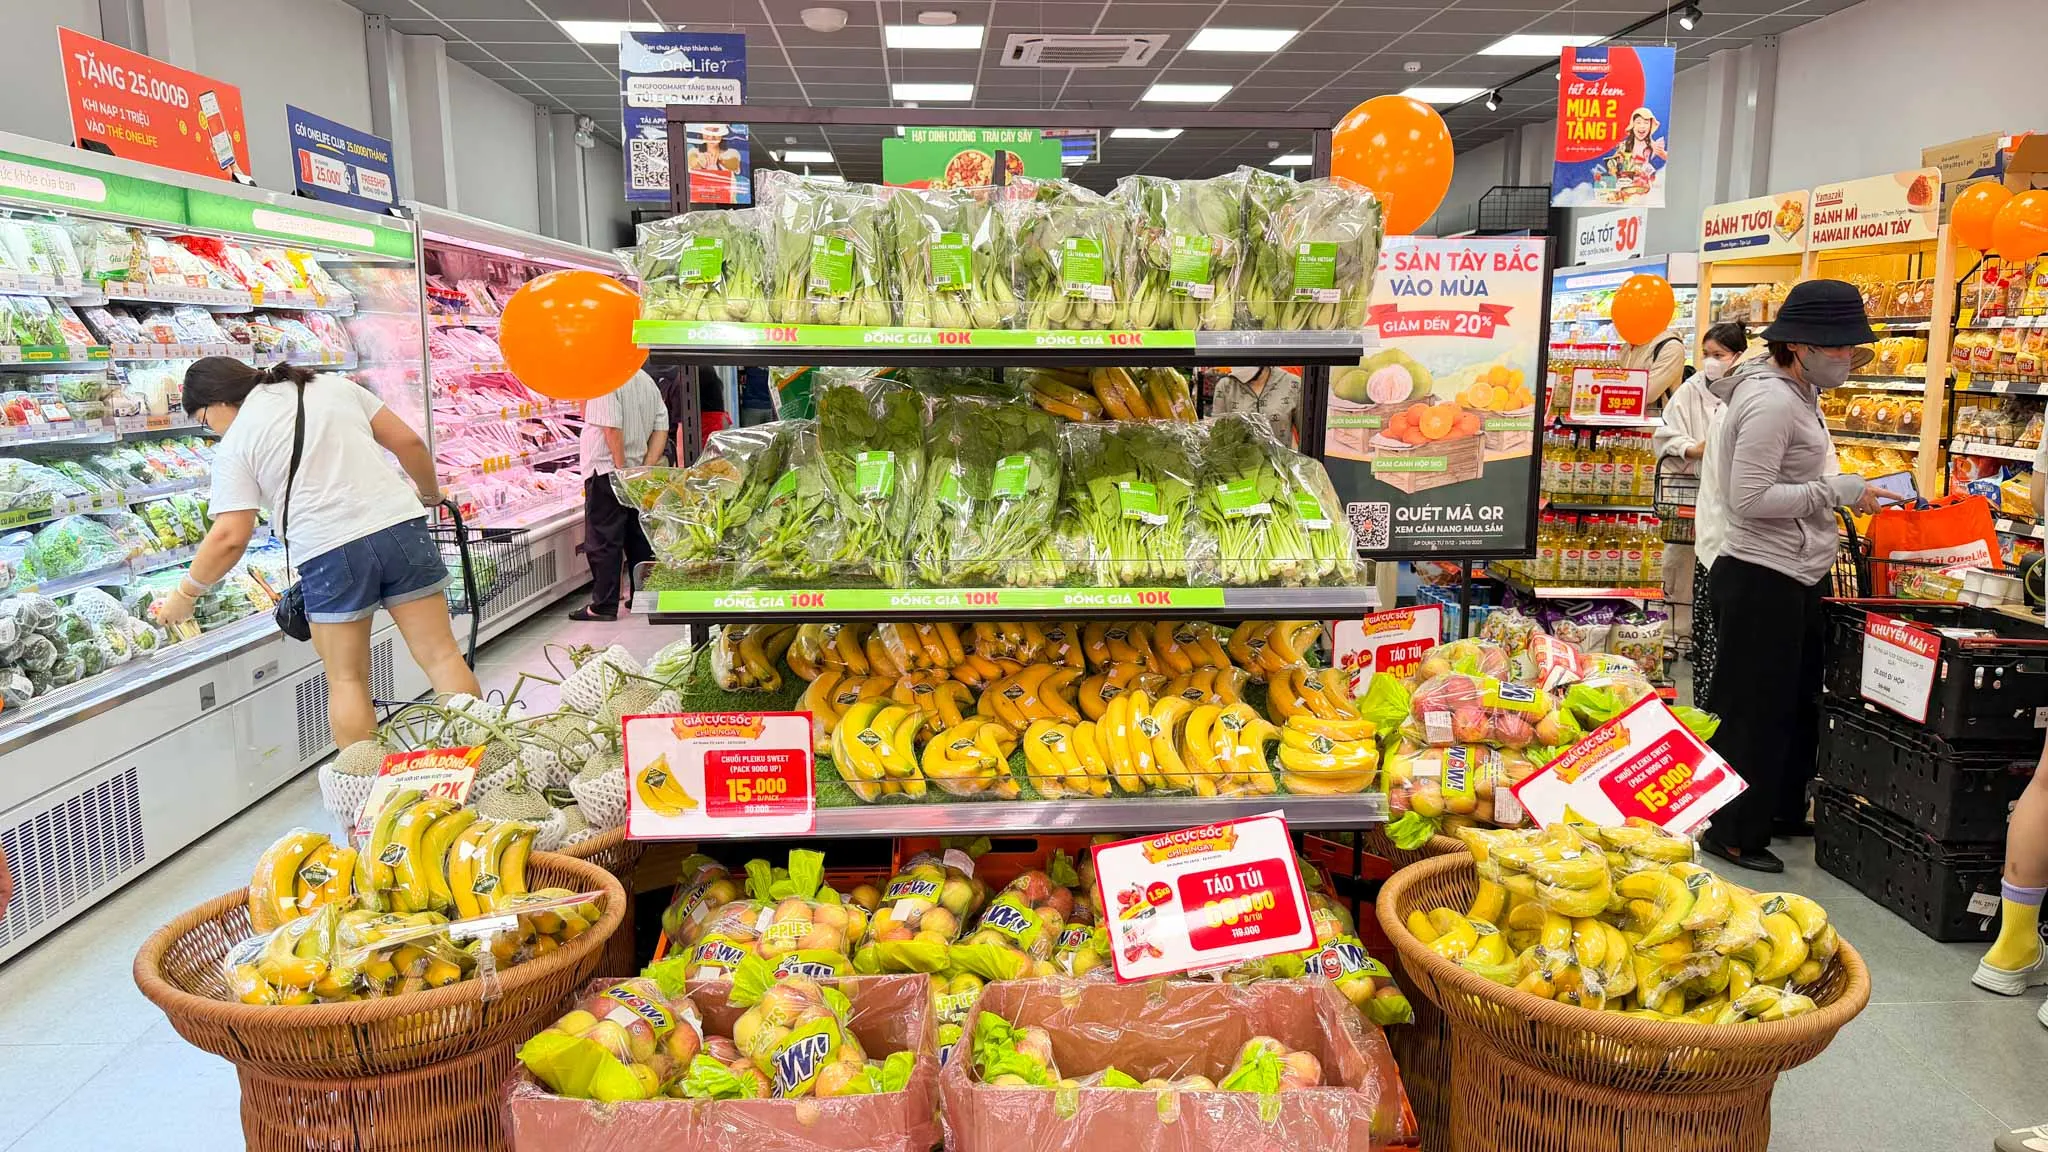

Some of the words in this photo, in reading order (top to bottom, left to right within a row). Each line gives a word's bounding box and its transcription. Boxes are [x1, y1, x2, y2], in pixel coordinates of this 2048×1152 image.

[660, 58, 727, 73] OneLife?
[74, 50, 126, 89] TẶNG
[128, 70, 190, 109] 25.000Đ
[1601, 82, 1625, 96] kem
[82, 97, 98, 111] KHI
[99, 102, 118, 119] NẠP
[119, 108, 125, 121] 1
[125, 108, 150, 128] TRIỆU
[1566, 99, 1601, 118] MUA
[1606, 99, 1617, 118] 2
[85, 116, 105, 135] VÀO
[106, 124, 125, 140] THẺ
[126, 129, 159, 148] ONELIFE
[294, 122, 307, 137] GÓI
[307, 127, 331, 146] ONELIFE
[928, 130, 948, 142] DINH
[1566, 116, 1607, 144] TẶNG
[1611, 122, 1617, 141] 1
[1815, 188, 1844, 202] Yamazaki
[1705, 214, 1739, 237] BÁNH
[1741, 209, 1773, 232] TƯƠI
[1813, 207, 1842, 225] BÁNH
[1844, 203, 1858, 221] MÌ
[1580, 225, 1595, 246] GIÁ
[1597, 220, 1615, 243] TỐT
[1812, 226, 1850, 244] HAWAII
[1852, 221, 1888, 239] KHOAI
[1890, 216, 1912, 235] TÂY
[1394, 247, 1440, 272] SẢN
[1446, 247, 1488, 272] TÂY
[1493, 244, 1539, 272] BẮC
[1390, 275, 1433, 297] VÀO
[1440, 275, 1489, 297] MÙA
[1383, 317, 1420, 333] GIẢM
[1454, 313, 1492, 334] 20%
[763, 327, 799, 342] 10K
[864, 330, 905, 344] ĐỒNG
[908, 330, 933, 344] GIÁ
[937, 331, 972, 345] 10K
[1035, 333, 1076, 346] ĐỒNG
[1079, 332, 1104, 346] GIÁ
[1109, 332, 1143, 346] 10K
[1395, 503, 1443, 521] QUÉT
[1446, 503, 1474, 520] MÃ
[1478, 506, 1504, 520] QR
[1436, 525, 1462, 533] NANG
[1485, 522, 1504, 532] SẮM
[1947, 549, 1988, 564] OneLife
[760, 594, 785, 608] GIÁ
[790, 593, 825, 608] 10K
[890, 592, 931, 606] ĐỒNG
[935, 592, 960, 606] GIÁ
[965, 591, 999, 605] 10K
[1064, 591, 1105, 605] ĐỒNG
[1107, 591, 1133, 605] GIÁ
[1137, 591, 1172, 605] 10K
[1871, 623, 1909, 643] KHUYẾN
[1390, 646, 1406, 662] TÁO
[1408, 643, 1422, 660] TÚI
[1386, 661, 1419, 679] 69.00
[683, 714, 703, 726] GIÁ
[704, 715, 727, 726] CỰC
[729, 713, 752, 725] SỐC
[1560, 749, 1579, 768] GIÁ
[1576, 738, 1597, 756] CỰC
[1595, 727, 1616, 745] SỐC
[1649, 740, 1672, 758] SWEET
[390, 756, 409, 776] GIÁ
[410, 754, 438, 771] CHẤN
[437, 754, 468, 770] ĐỘNG
[721, 754, 741, 763] CHUỐI
[742, 755, 766, 763] PLEIKU
[729, 765, 751, 774] (PACK
[769, 764, 782, 773] UP)
[726, 777, 787, 803] 15.000
[1634, 762, 1693, 813] 15.000
[1153, 832, 1173, 848] GIÁ
[1174, 830, 1197, 843] CỰC
[1199, 825, 1223, 838] SỐC
[888, 881, 937, 896] WOW!
[1203, 873, 1235, 896] TÁO
[1235, 867, 1264, 890] TÚI
[609, 987, 667, 1028] WOW!
